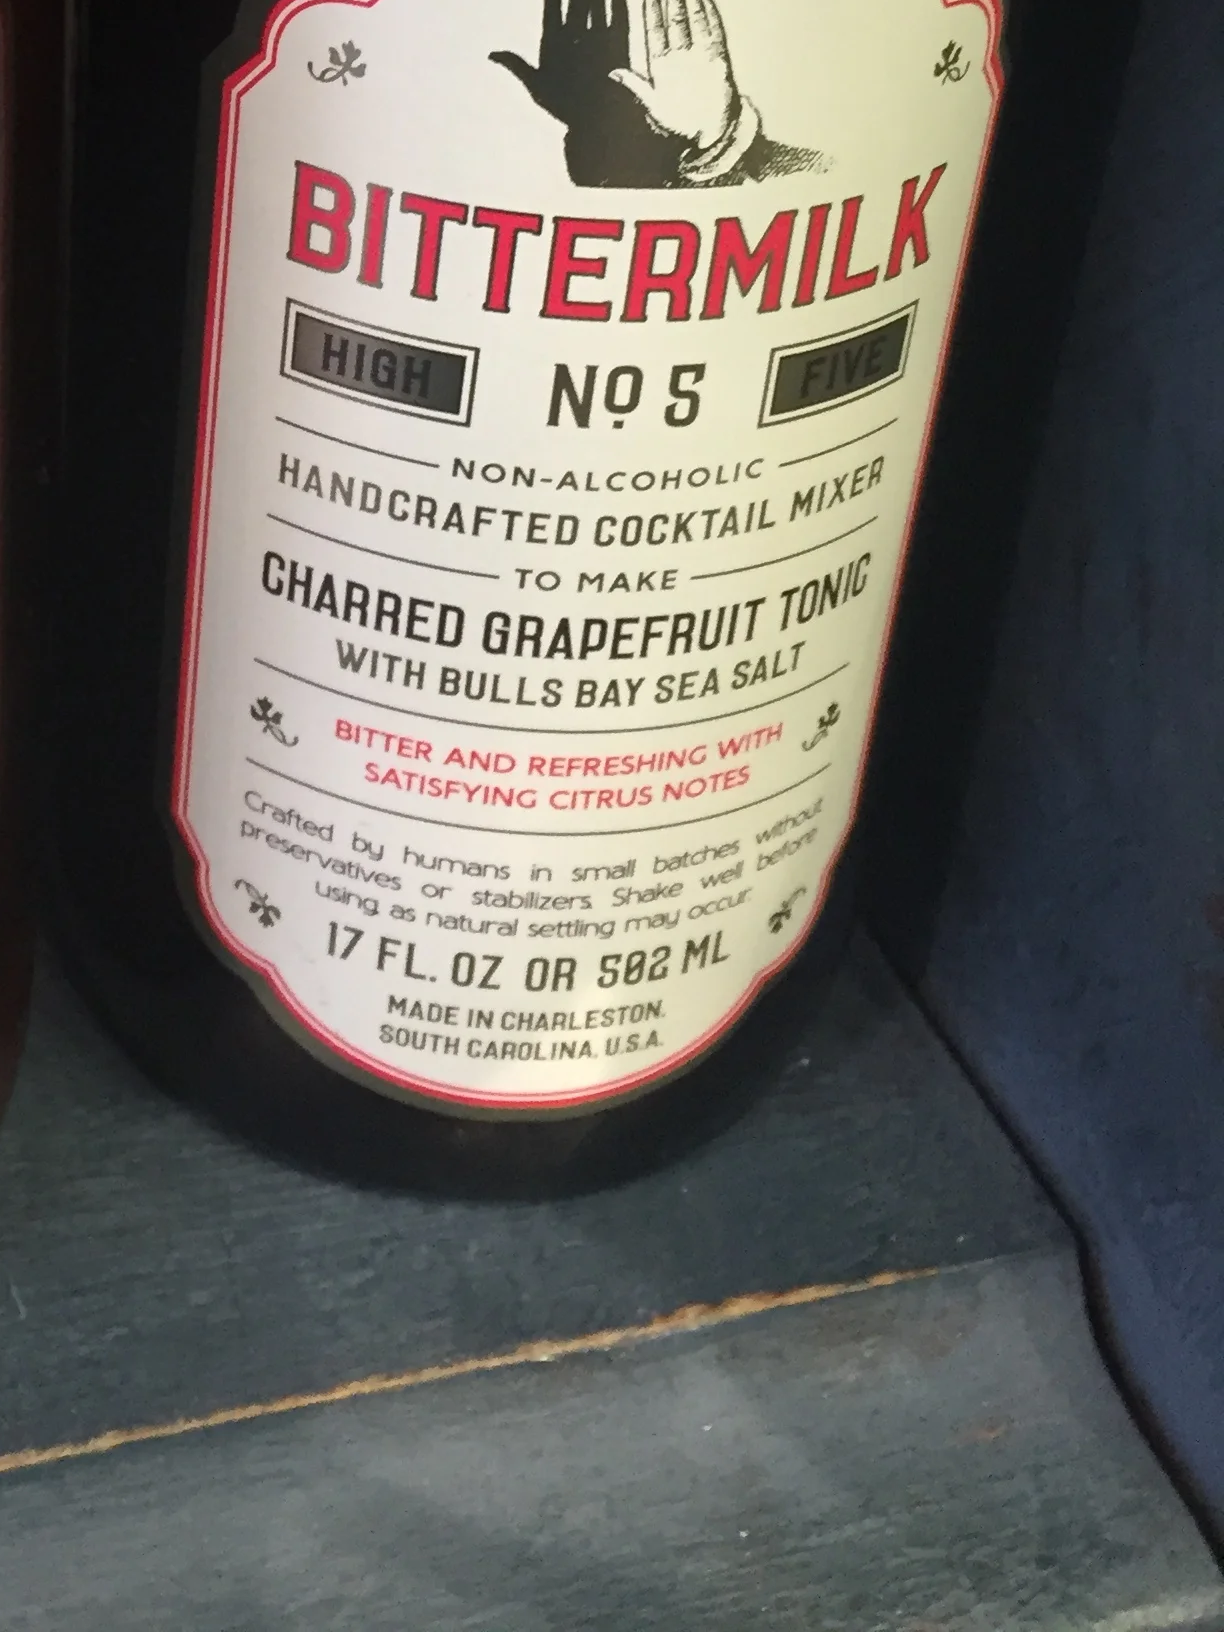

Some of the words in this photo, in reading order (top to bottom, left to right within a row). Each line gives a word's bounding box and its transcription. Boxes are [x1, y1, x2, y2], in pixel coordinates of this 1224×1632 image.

[285, 159, 948, 323] BITTERMILK
[321, 331, 433, 400] HIGH
[664, 362, 707, 428] 5
[799, 335, 888, 400] FIVE
[277, 451, 581, 546] HANDCRAFTED
[593, 498, 776, 548] COCKTAIL
[788, 454, 885, 523] MIXER
[451, 456, 765, 492] NON-ALCOHOLIC
[261, 550, 466, 649] CHARRED
[482, 596, 767, 661] GRAPEFRUIT
[779, 551, 872, 633] TONIC
[515, 567, 562, 592] TO
[576, 568, 679, 594] MAKE
[335, 638, 427, 691] WITH
[438, 665, 564, 709] BULLS
[574, 676, 646, 709] BAY
[653, 667, 720, 705] SEA
[730, 639, 807, 691] SALT
[334, 718, 433, 764] BITTER
[443, 746, 517, 775] AND
[527, 744, 708, 777] REFRESHING
[717, 721, 784, 761] WITH
[363, 761, 538, 810] SATISFYING
[549, 784, 653, 811] CITRUS
[661, 764, 752, 803] NOTES
[239, 819, 403, 892] preservatives
[421, 882, 454, 900] or
[611, 881, 685, 908] Shake
[699, 860, 745, 889] well
[755, 826, 819, 872] before
[243, 789, 335, 843] Crafted
[351, 831, 385, 862] by
[402, 844, 511, 881] humans
[529, 863, 552, 882] in
[571, 858, 637, 883] small
[652, 839, 740, 875] batches
[754, 797, 824, 845] without
[389, 903, 417, 923] as
[424, 910, 519, 938] natural
[527, 916, 616, 940] settling
[623, 908, 681, 933] may
[326, 920, 366, 961] 17
[375, 935, 438, 983] FL.
[450, 950, 505, 991] OZ
[524, 955, 578, 992] OR
[596, 944, 672, 989] 502
[680, 929, 731, 975] ML
[378, 1023, 461, 1056] SOUTH
[386, 993, 461, 1026] MADE
[467, 1007, 495, 1031] IN
